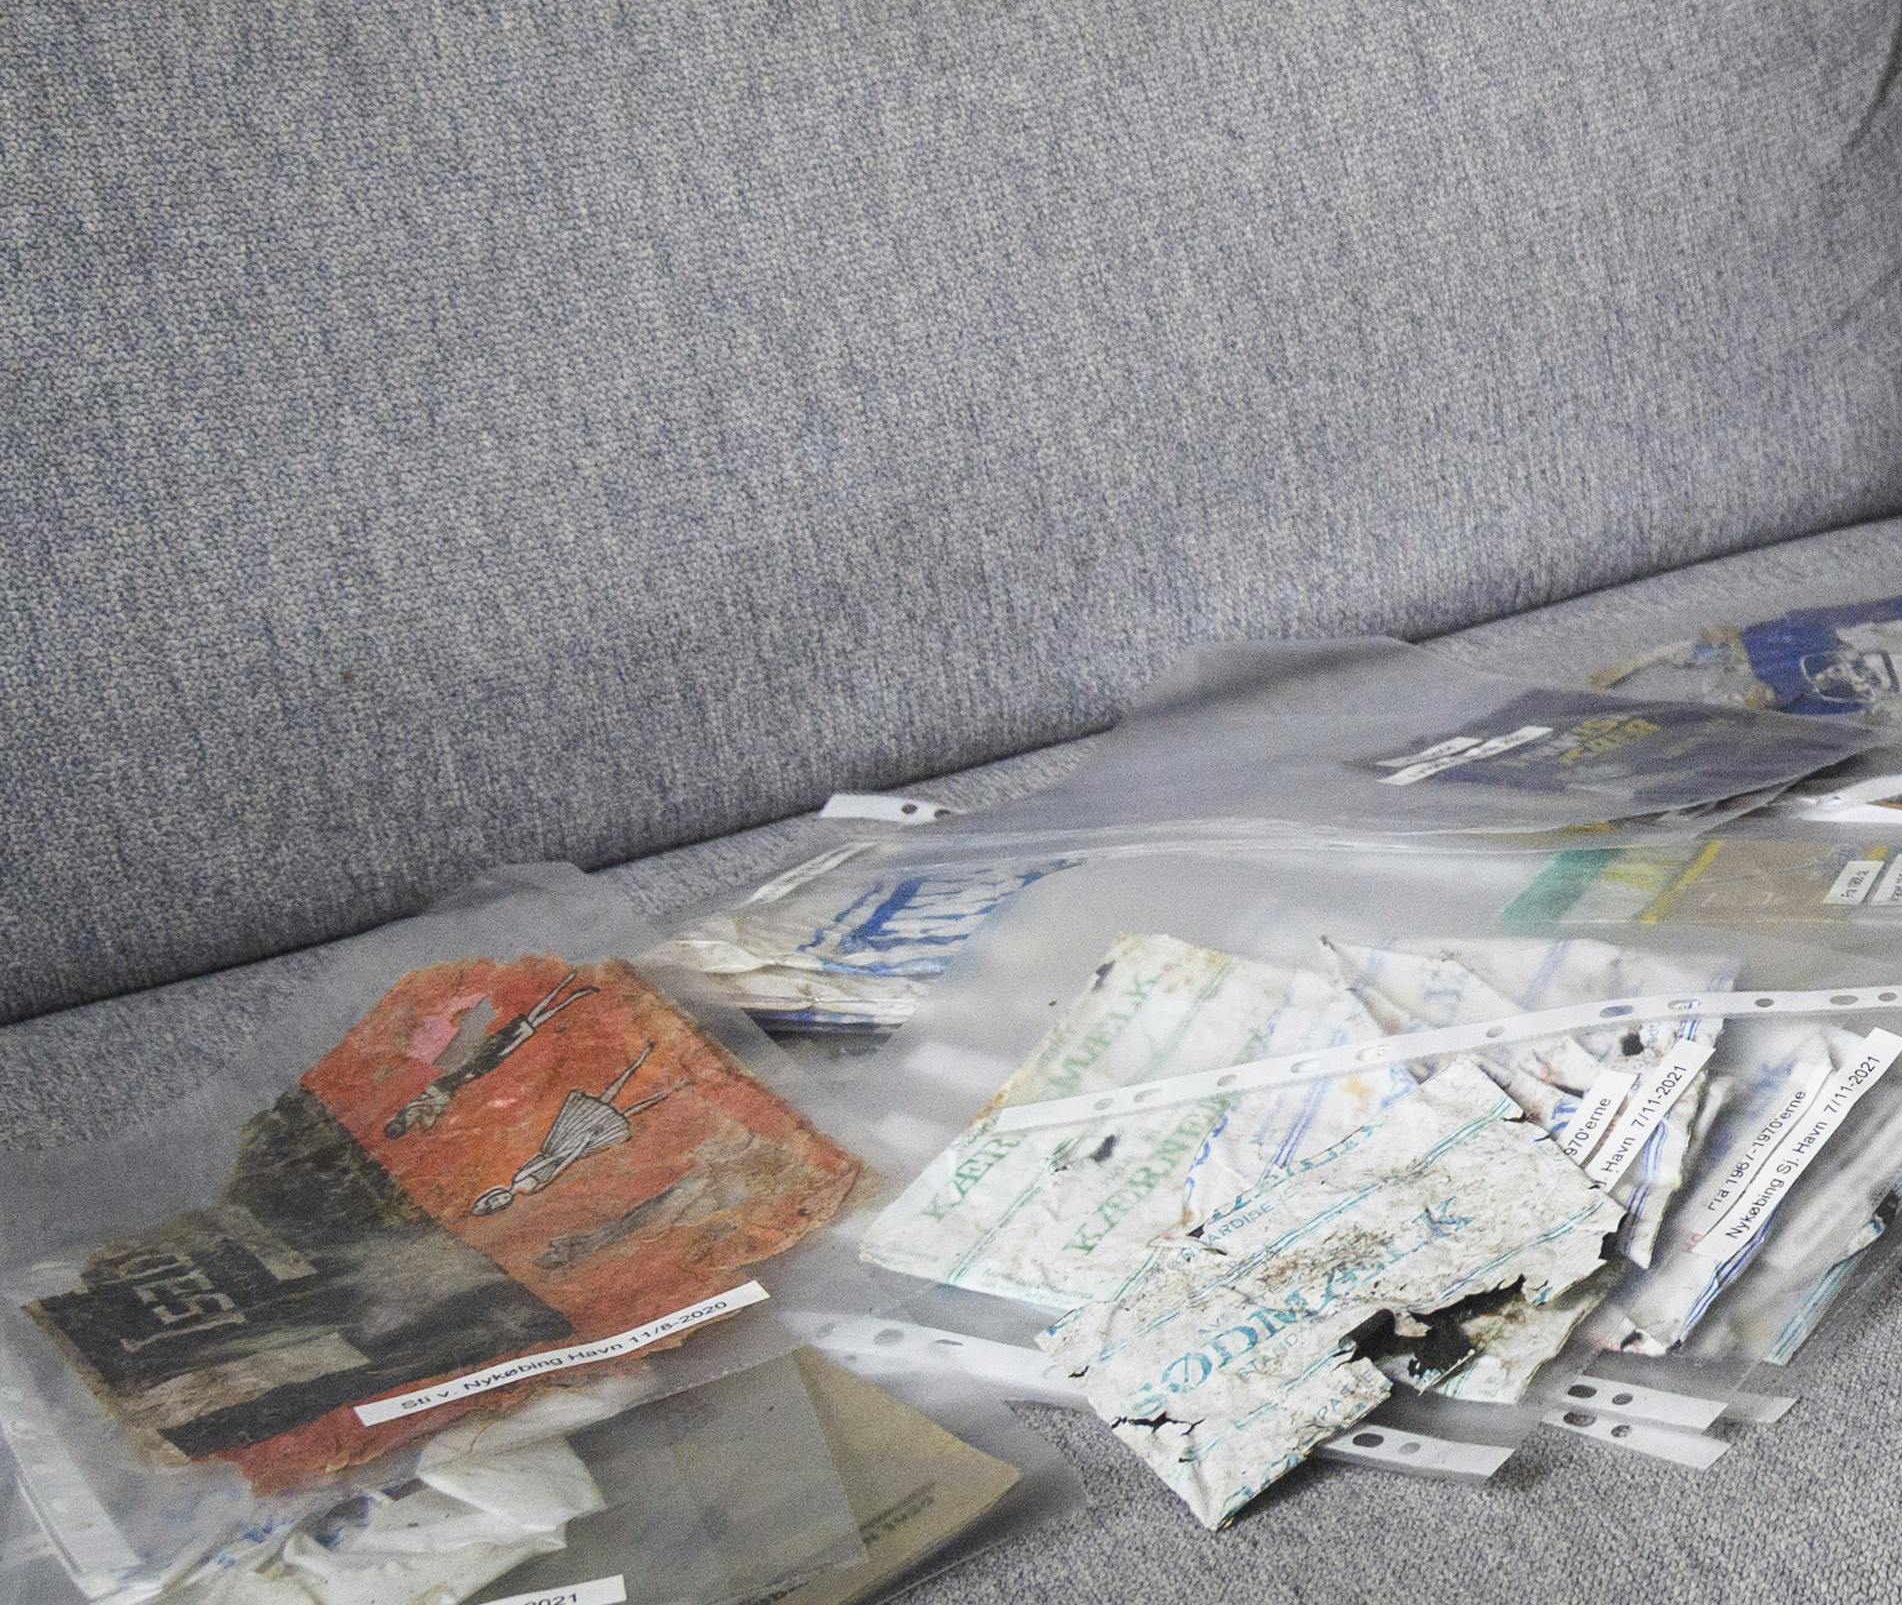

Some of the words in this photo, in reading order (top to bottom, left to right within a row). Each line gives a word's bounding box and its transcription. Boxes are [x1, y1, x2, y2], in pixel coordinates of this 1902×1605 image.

[1601, 1137, 1636, 1173] Havn
[1631, 1064, 1687, 1128] 7/11-2021
[1726, 1177, 1785, 1239] Nykøbing
[1776, 1157, 1800, 1175] Sj.
[1792, 1121, 1829, 1155] Havn
[1824, 1055, 1881, 1115] 7/11-2021
[401, 1394, 432, 1411] Sti
[463, 1355, 565, 1392] Nykøbing
[568, 1341, 624, 1362] Havn
[628, 1300, 729, 1344] 11/8-2020
